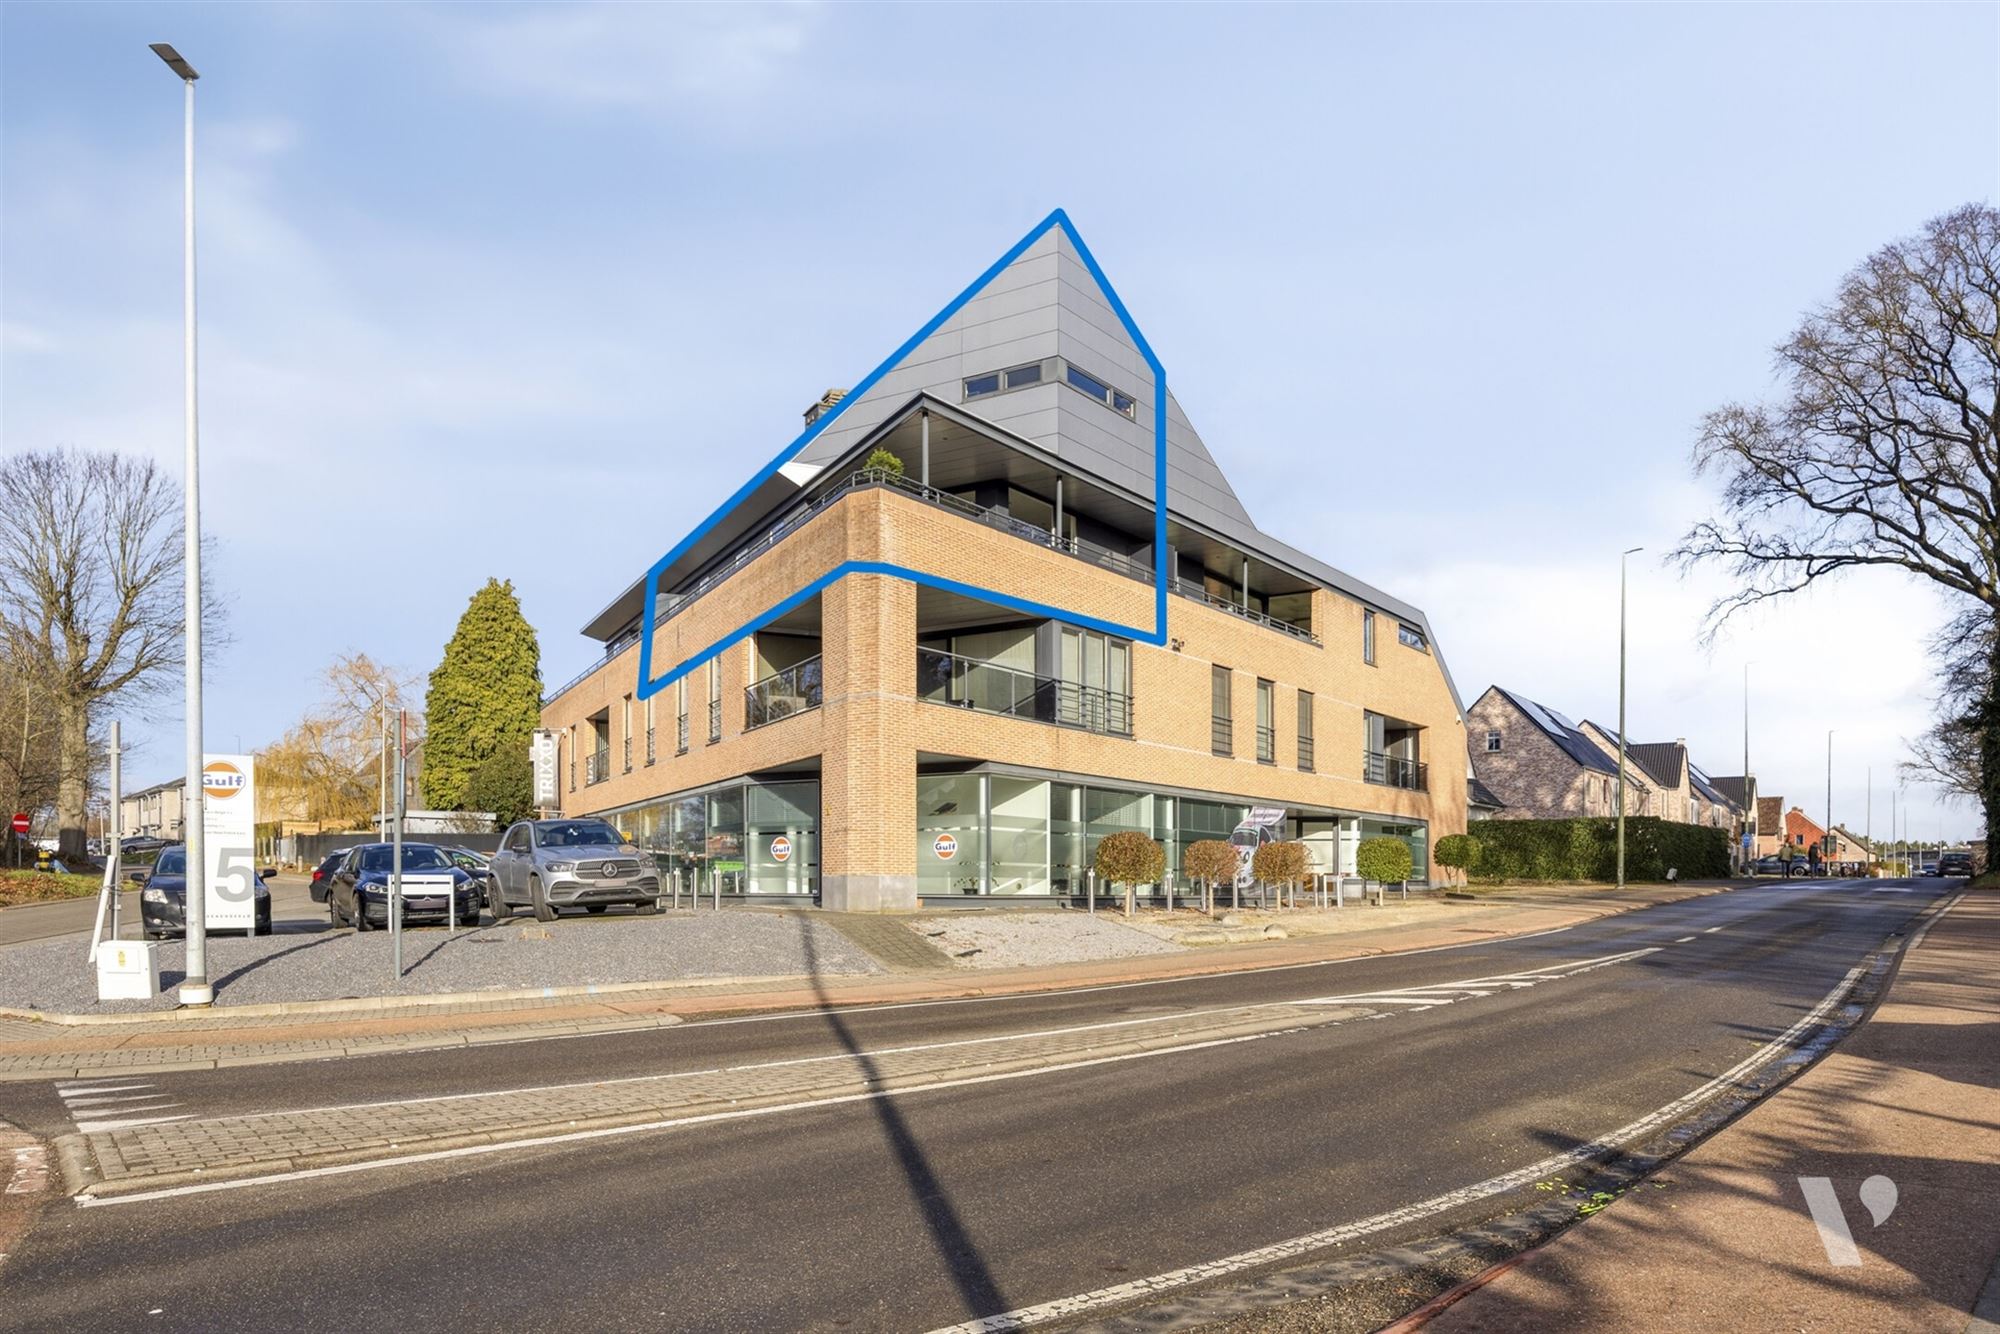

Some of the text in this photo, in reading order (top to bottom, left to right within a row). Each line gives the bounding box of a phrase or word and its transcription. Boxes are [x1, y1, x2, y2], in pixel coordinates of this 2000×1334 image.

[202, 774, 243, 786] Gulf
[539, 739, 553, 801] TRIXXO
[935, 842, 956, 850] Gulf
[215, 848, 254, 903] 5
